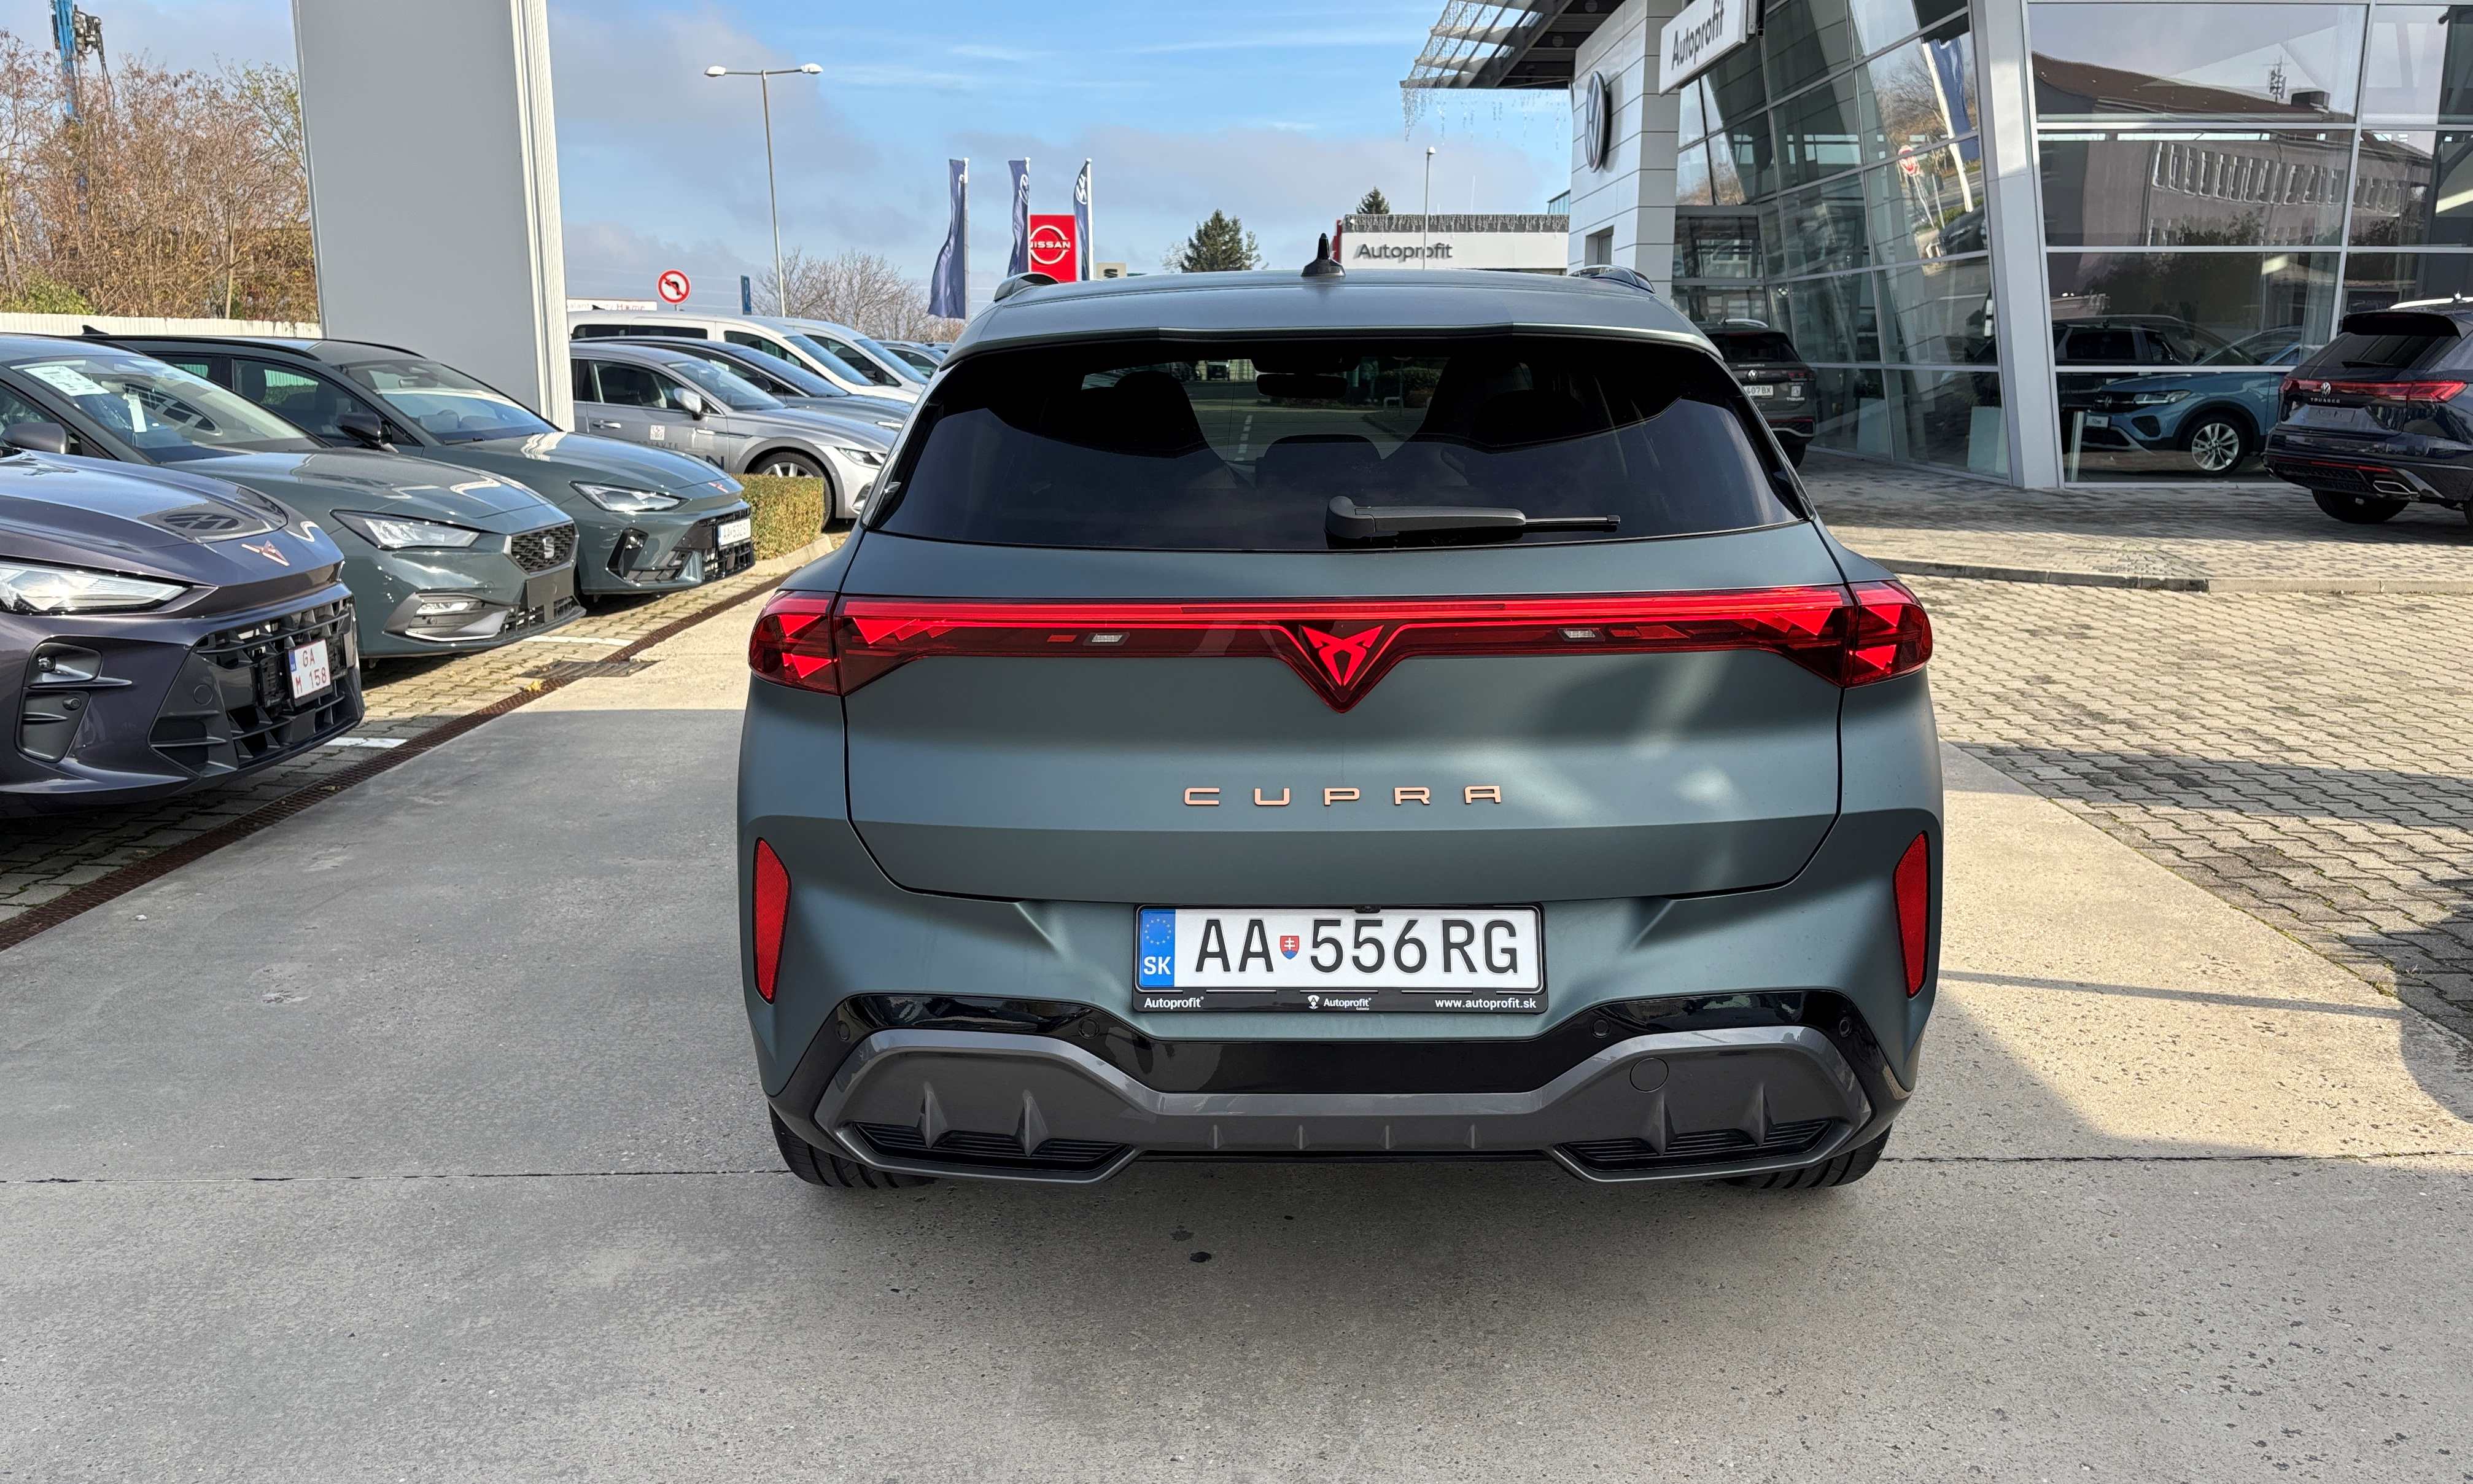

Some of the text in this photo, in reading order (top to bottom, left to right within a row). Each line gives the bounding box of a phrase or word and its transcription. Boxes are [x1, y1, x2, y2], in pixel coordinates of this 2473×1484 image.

[1671, 0, 1724, 70] Autoprofit
[1358, 243, 1453, 262] Autoprofit
[303, 648, 316, 667] GA
[295, 667, 327, 694] M 158
[1184, 786, 1501, 806] CUPRA
[1195, 919, 1274, 973] AA
[1144, 956, 1171, 975] SK
[1435, 998, 1537, 1010] www.autoprofit.sk
